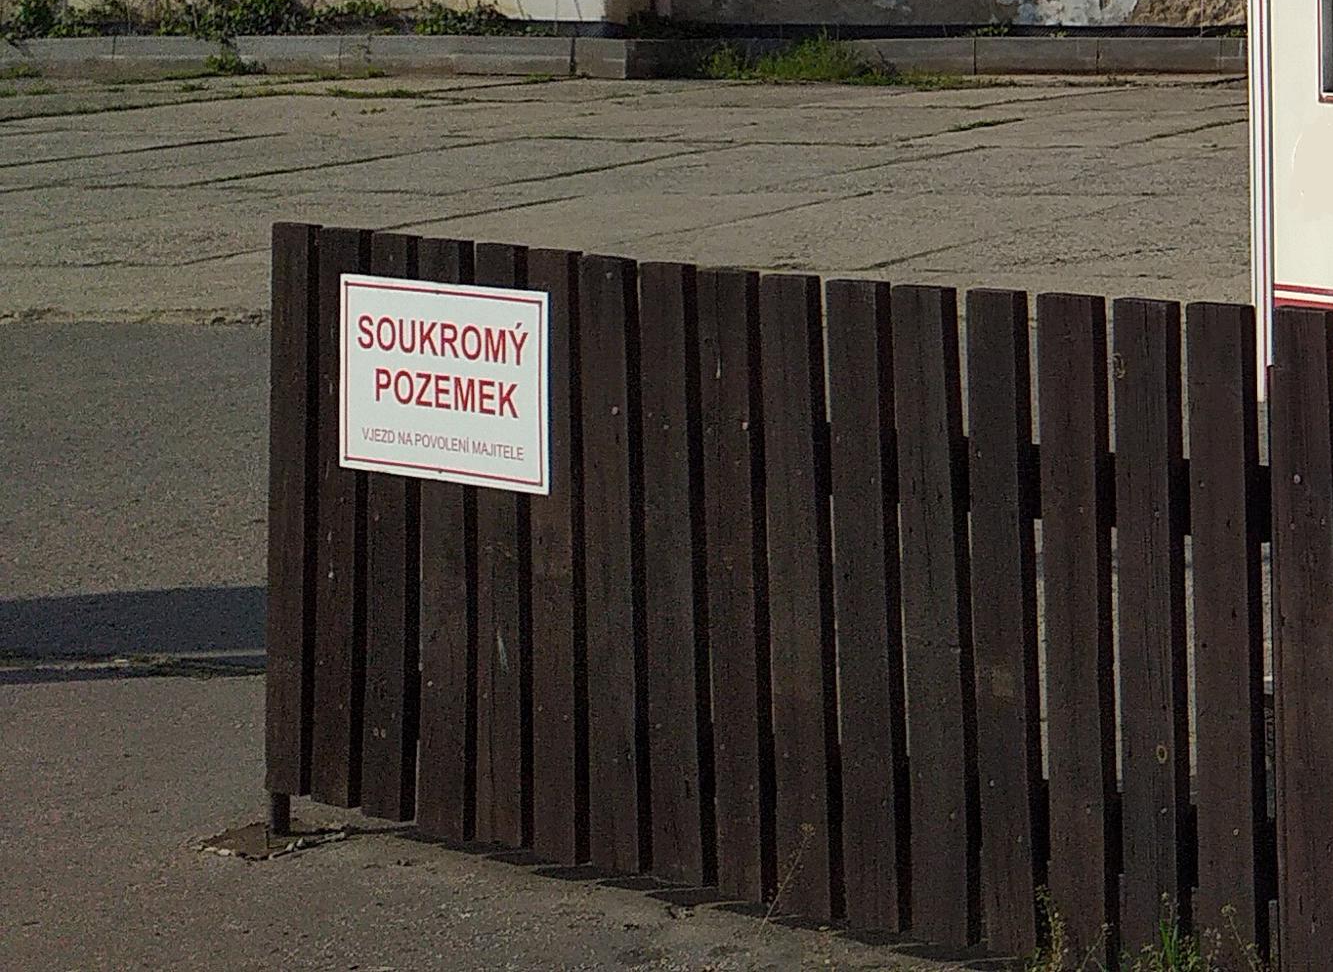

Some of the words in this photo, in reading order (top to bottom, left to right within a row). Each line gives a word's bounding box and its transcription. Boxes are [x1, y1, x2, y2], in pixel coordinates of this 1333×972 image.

[357, 314, 529, 366] SOUKROMÝ
[375, 367, 519, 419] POZEMEK
[362, 427, 396, 444] VJEZD
[397, 431, 413, 446] NA
[415, 431, 470, 454] POVOLENÍ
[472, 440, 525, 462] MAJITELE
